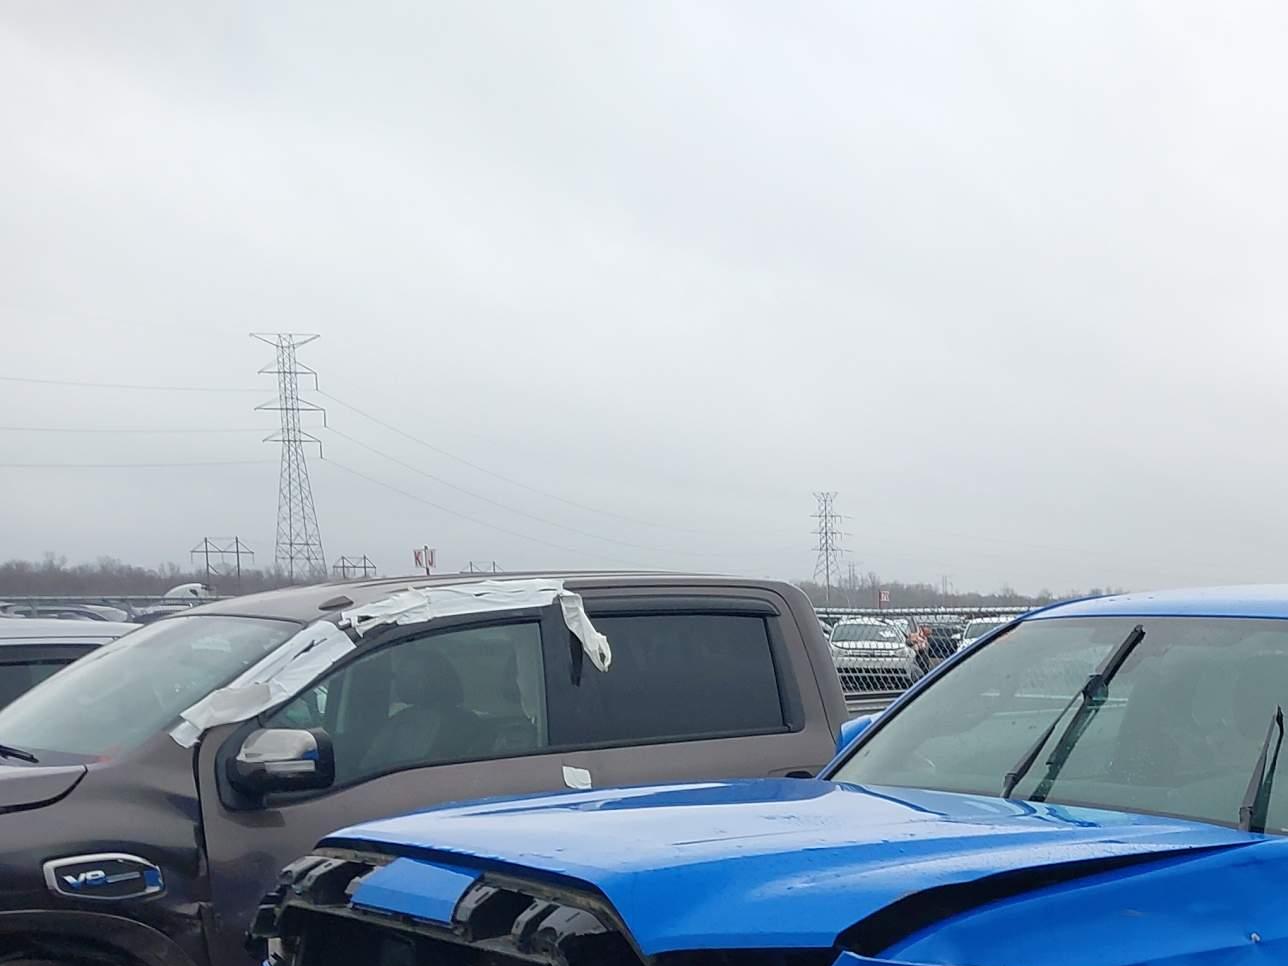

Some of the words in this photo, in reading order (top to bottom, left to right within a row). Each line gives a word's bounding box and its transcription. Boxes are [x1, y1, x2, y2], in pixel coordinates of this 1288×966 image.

[413, 550, 423, 568] K
[428, 550, 434, 567] J
[63, 870, 106, 889] V8
